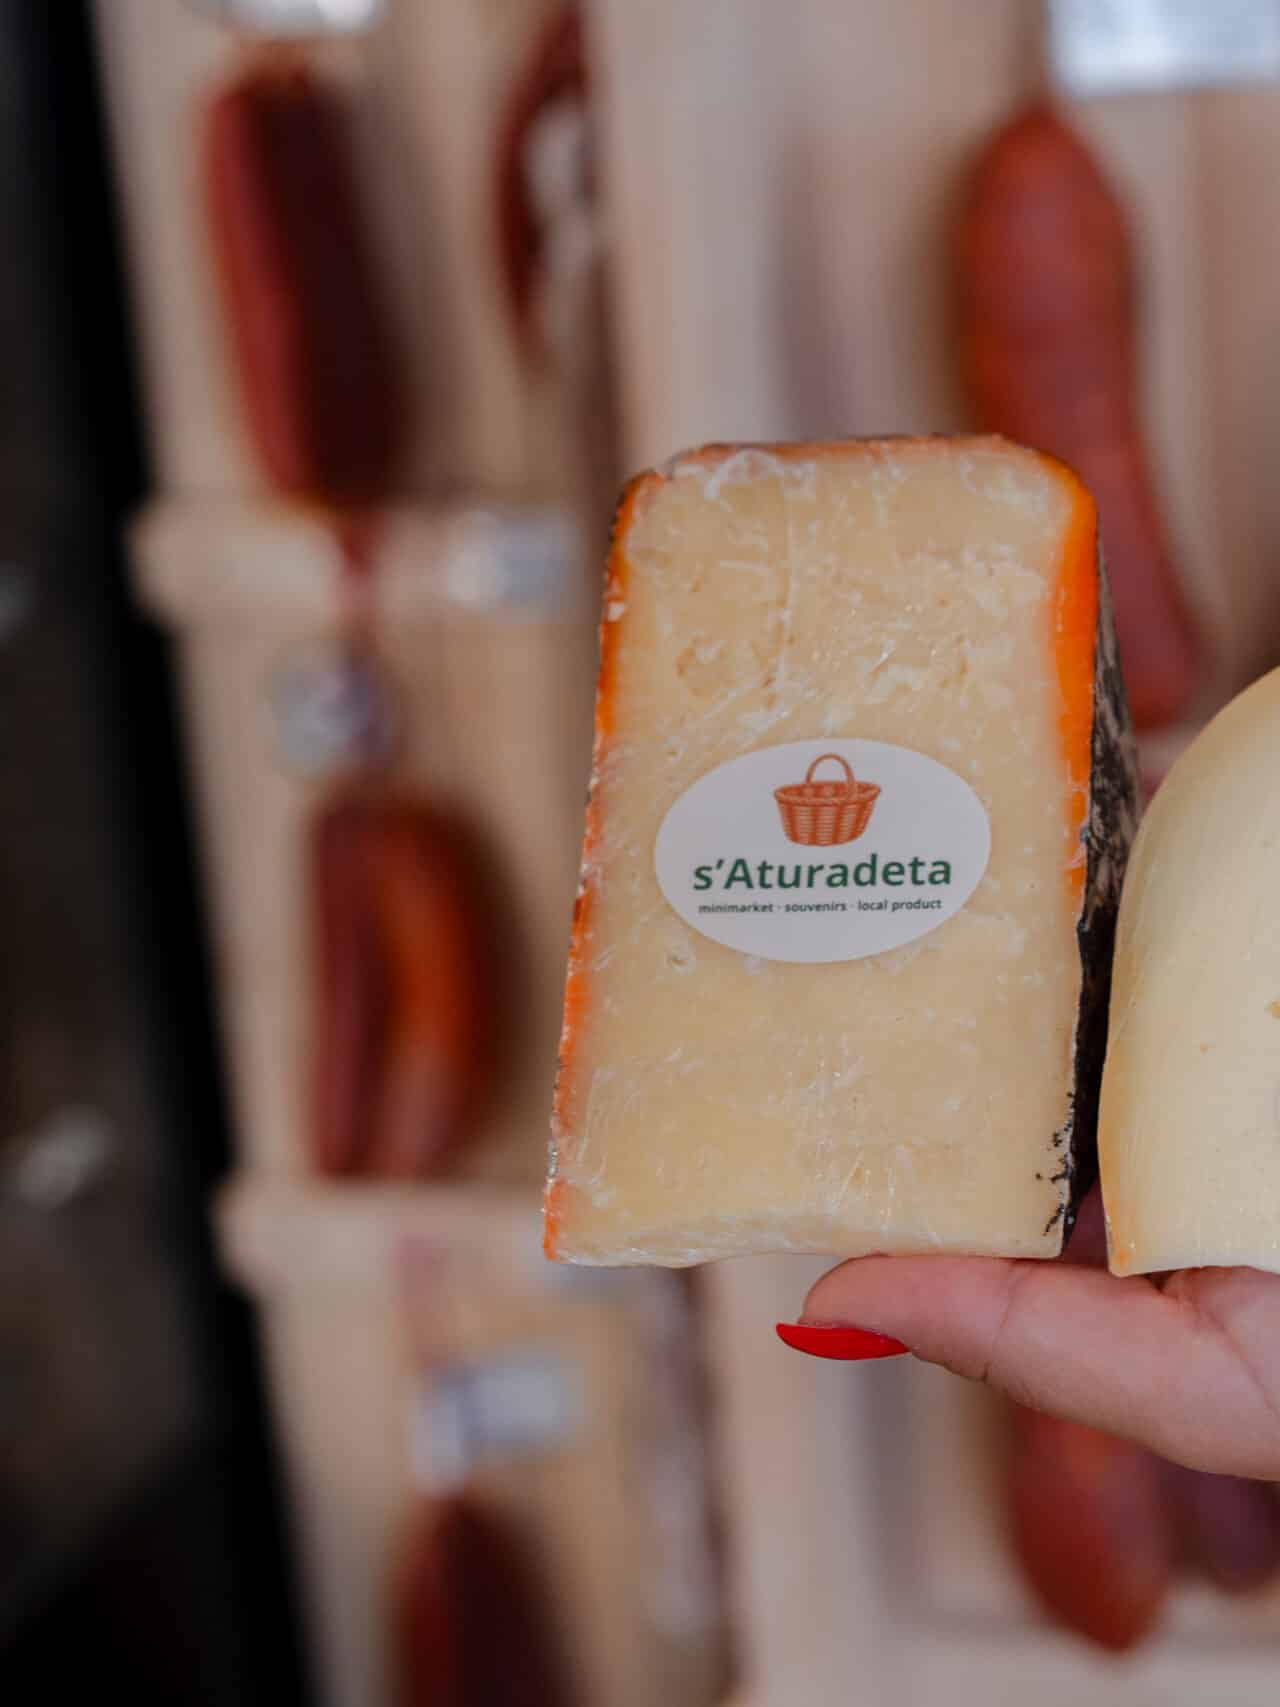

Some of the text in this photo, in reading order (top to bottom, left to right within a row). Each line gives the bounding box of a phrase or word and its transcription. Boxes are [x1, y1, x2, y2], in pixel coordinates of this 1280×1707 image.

[692, 852, 953, 891] s'Aturadeta
[698, 898, 943, 914] minimarket souvenirs local product
